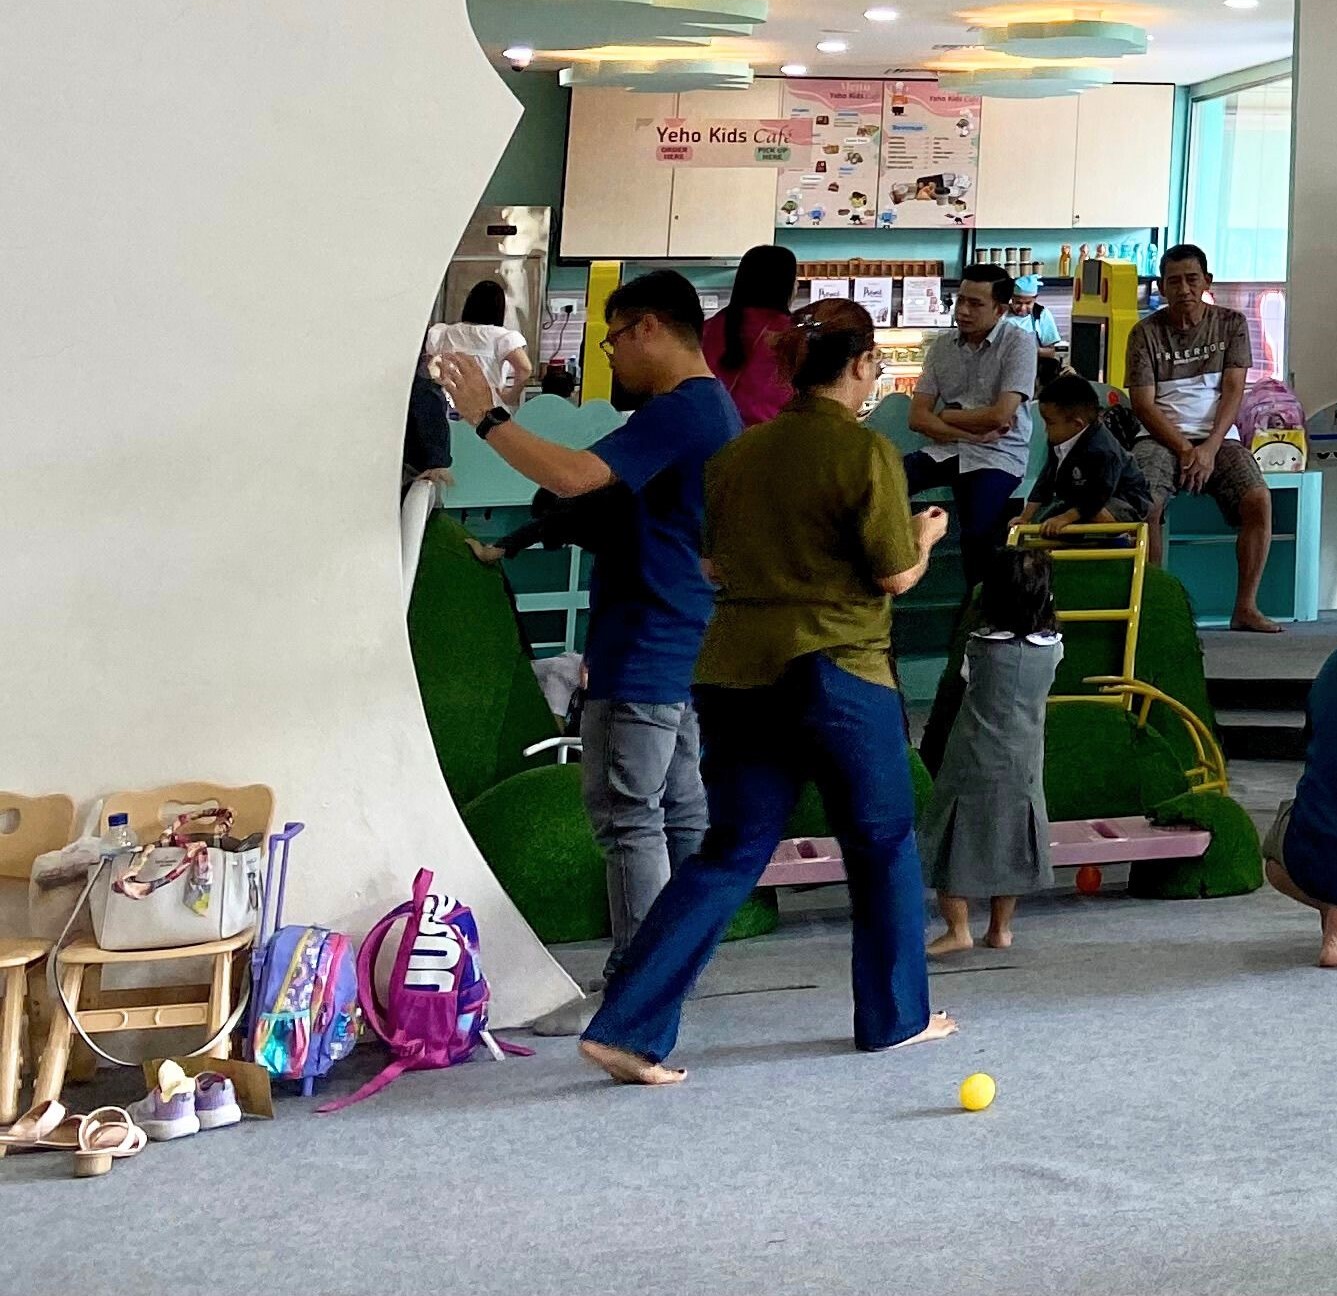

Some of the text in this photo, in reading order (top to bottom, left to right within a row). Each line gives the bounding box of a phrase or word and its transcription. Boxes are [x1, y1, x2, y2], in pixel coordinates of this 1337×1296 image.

[656, 124, 793, 146] Yeho Kids Café
